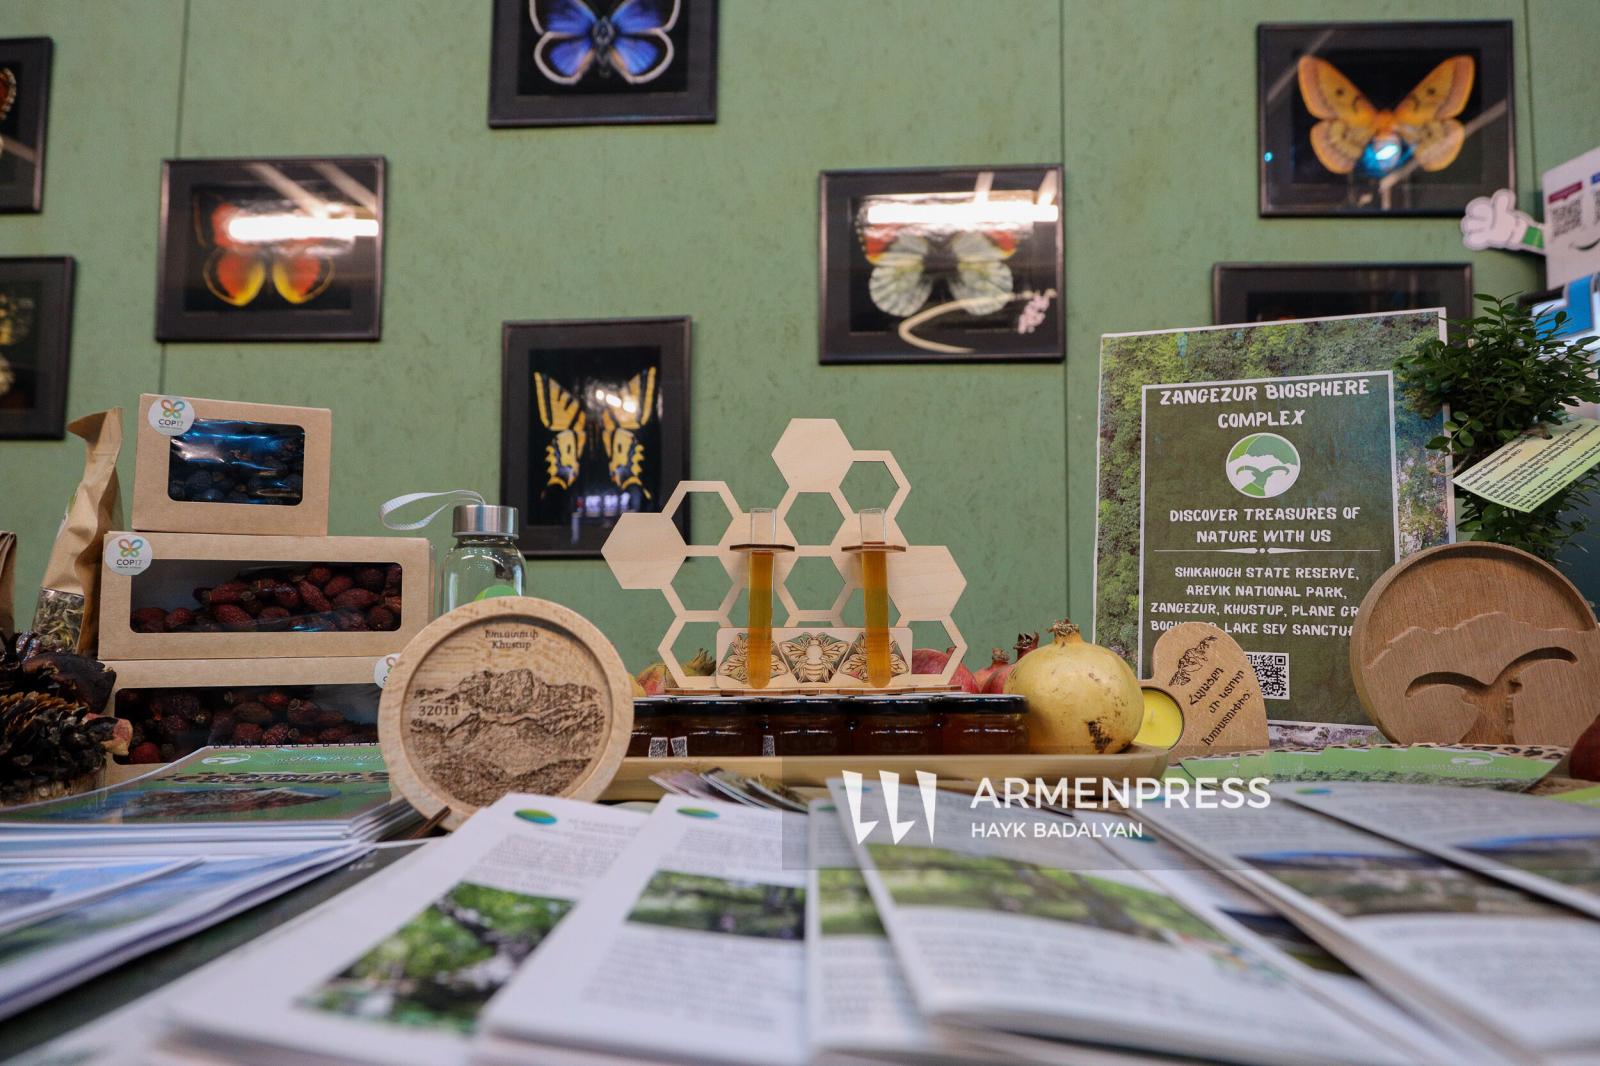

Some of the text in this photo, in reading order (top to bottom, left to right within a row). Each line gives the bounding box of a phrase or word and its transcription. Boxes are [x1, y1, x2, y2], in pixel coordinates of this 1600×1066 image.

[1160, 379, 1370, 405] ZANGEZUR BIOSPHERE
[1217, 409, 1306, 429] COMPLEX
[1169, 506, 1361, 522] DISCOVER TREASURES OF
[1196, 529, 1332, 543] NATURE WITH US
[1174, 566, 1360, 581] SHIKAHOGH STATE RESERVE,
[1186, 585, 1347, 600] AREVIK NATIONAL PARK,
[1150, 602, 1220, 616] ZANGEZUR,
[1224, 603, 1288, 617] KHUSTUP,
[1291, 605, 1336, 617] PLANE
[1225, 622, 1258, 635] LAKE
[1263, 623, 1288, 635] SEV
[492, 640, 531, 651] Khustup
